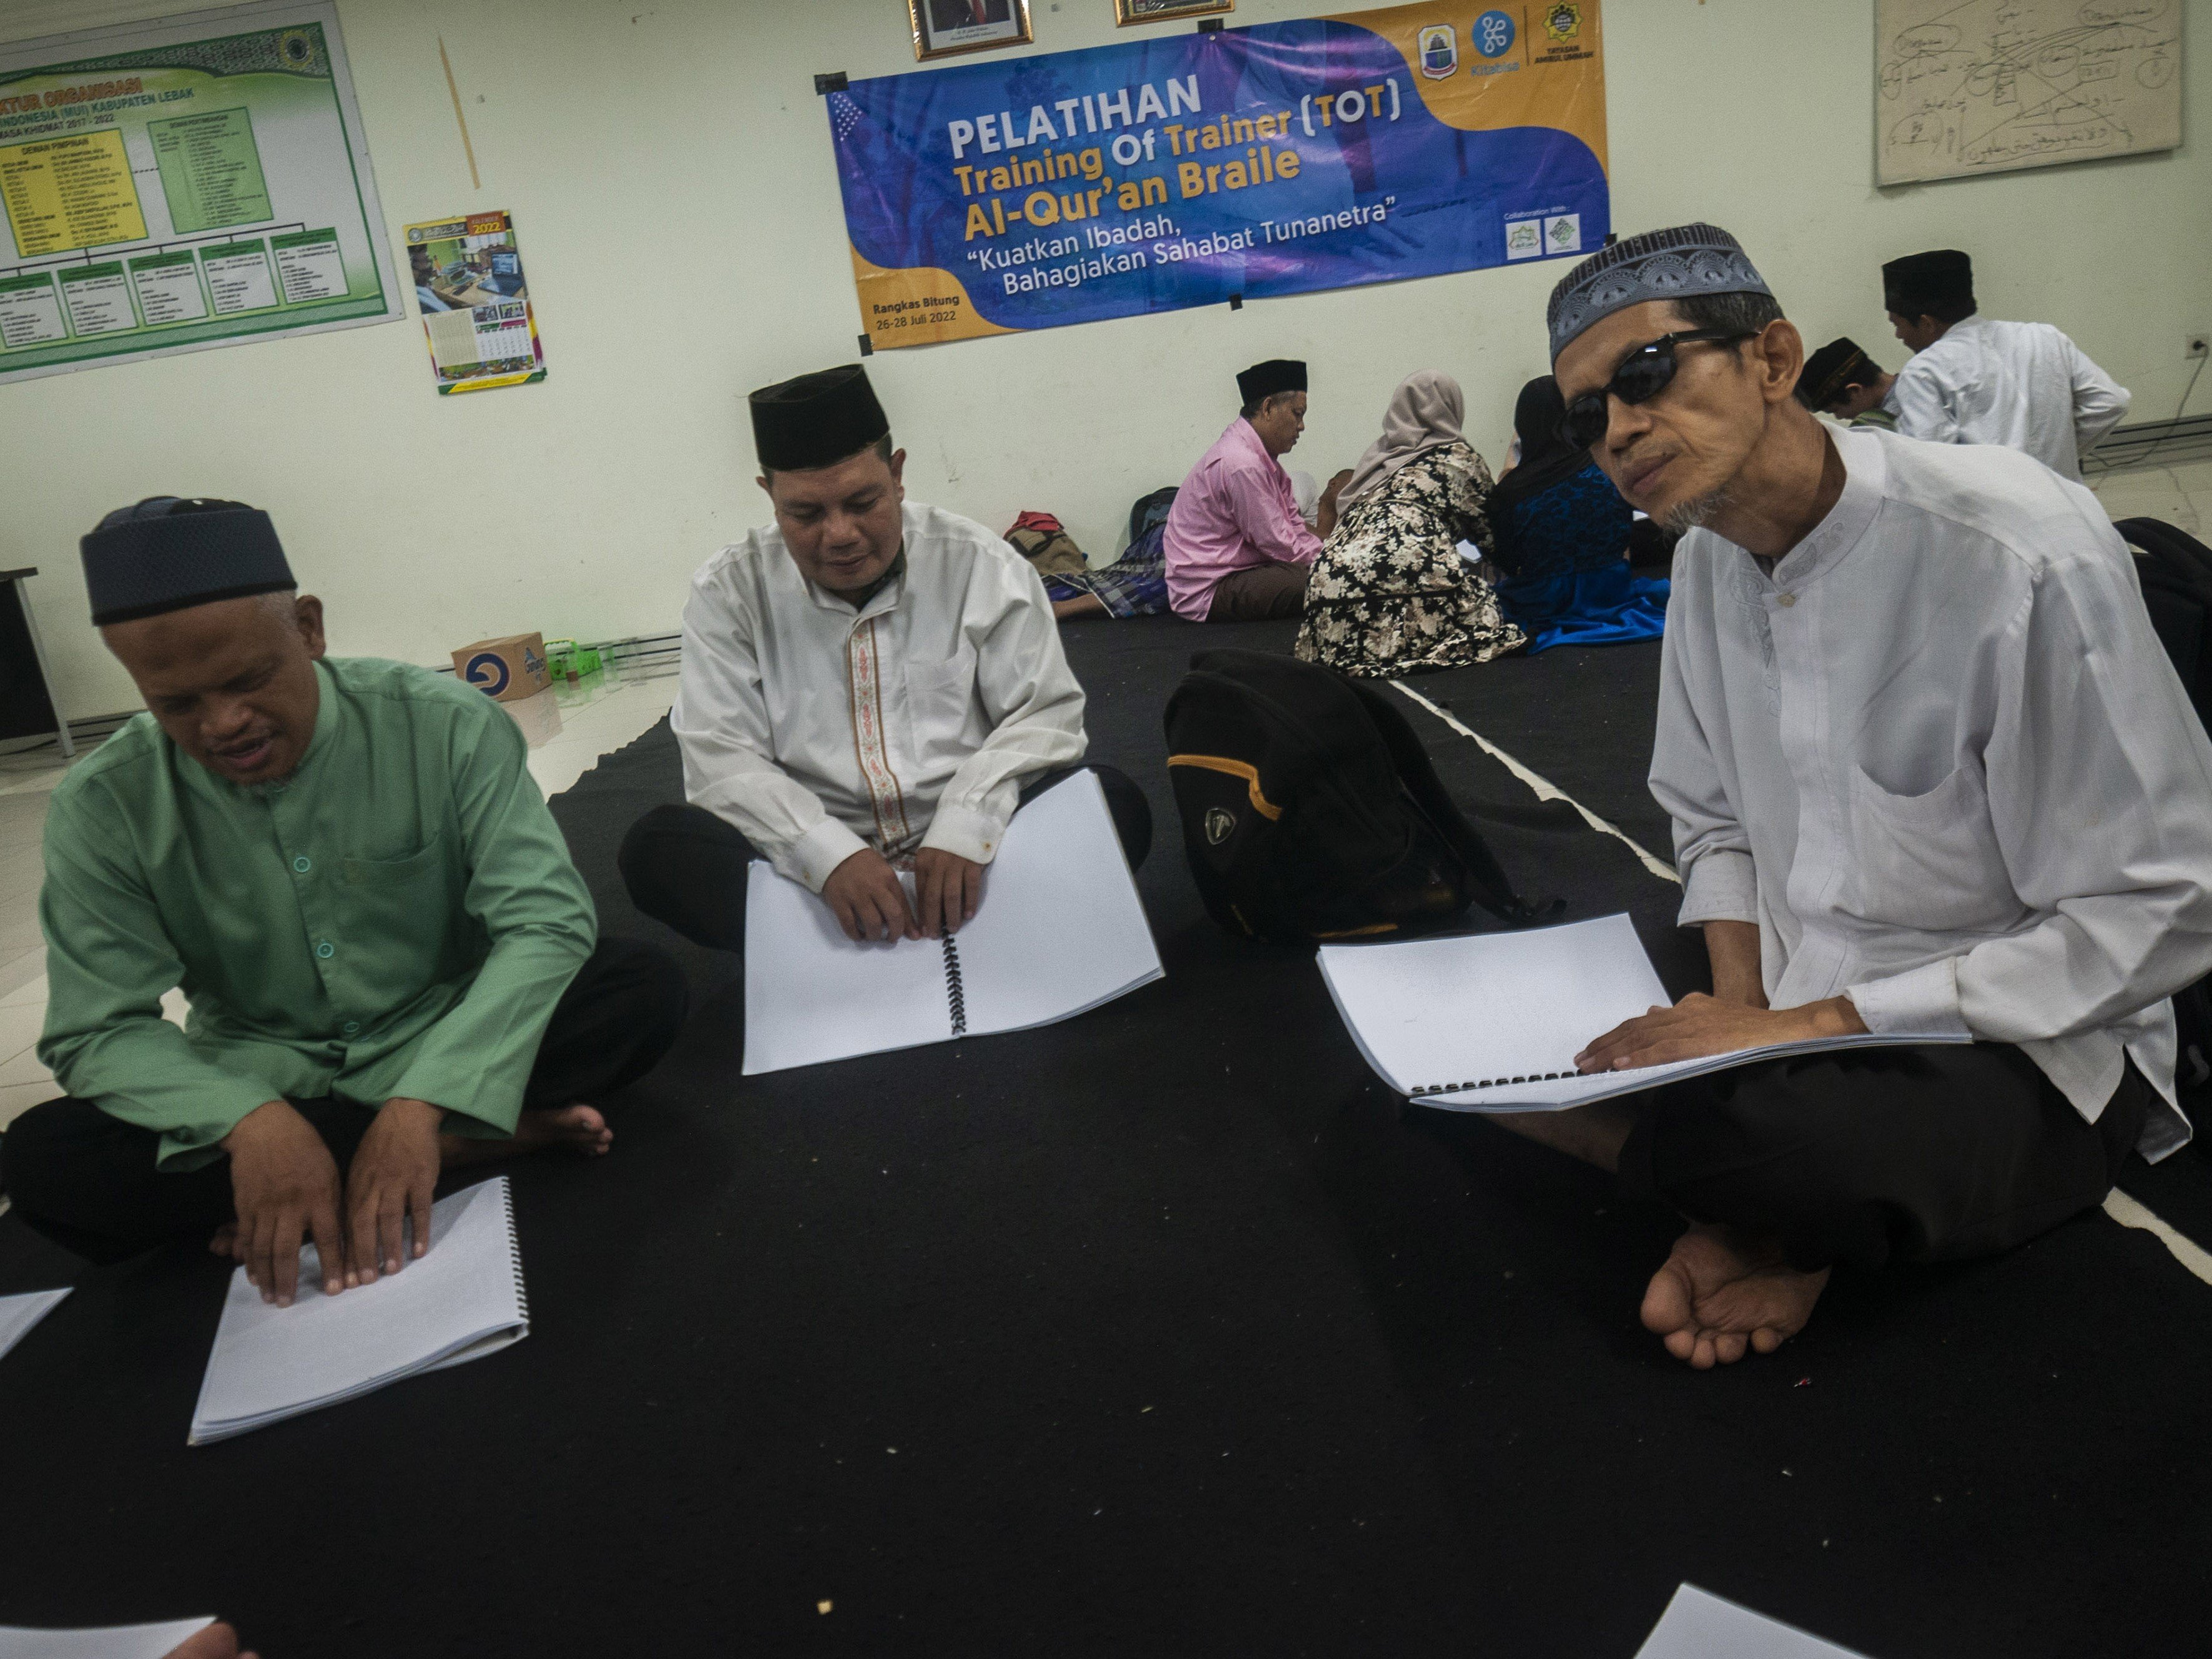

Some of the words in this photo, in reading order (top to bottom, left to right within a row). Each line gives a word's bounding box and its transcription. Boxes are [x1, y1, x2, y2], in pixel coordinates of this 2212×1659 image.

[91, 93, 156, 113] KABUPATEN
[157, 87, 194, 103] LEBAK
[948, 74, 1201, 159] PELATIHAN
[953, 147, 1104, 195] Training
[1112, 129, 1156, 166] Of
[1164, 110, 1292, 156] Trainer
[1300, 78, 1400, 137] (TOT)
[965, 175, 1168, 242] Al-Qur’an
[1178, 145, 1300, 199] Braile
[473, 222, 501, 235] 2022
[967, 237, 1079, 271] “Kuatkan
[1086, 214, 1181, 249] Ibadah,
[1003, 251, 1146, 295] Bahagiakan
[1153, 227, 1254, 265] Sahabat
[1260, 195, 1396, 244] Tunanetra”
[873, 300, 920, 314] Rangkas
[923, 296, 960, 307] Bitung
[876, 317, 907, 330] 26-28
[910, 314, 927, 325] Juli
[930, 311, 956, 323] 2022
